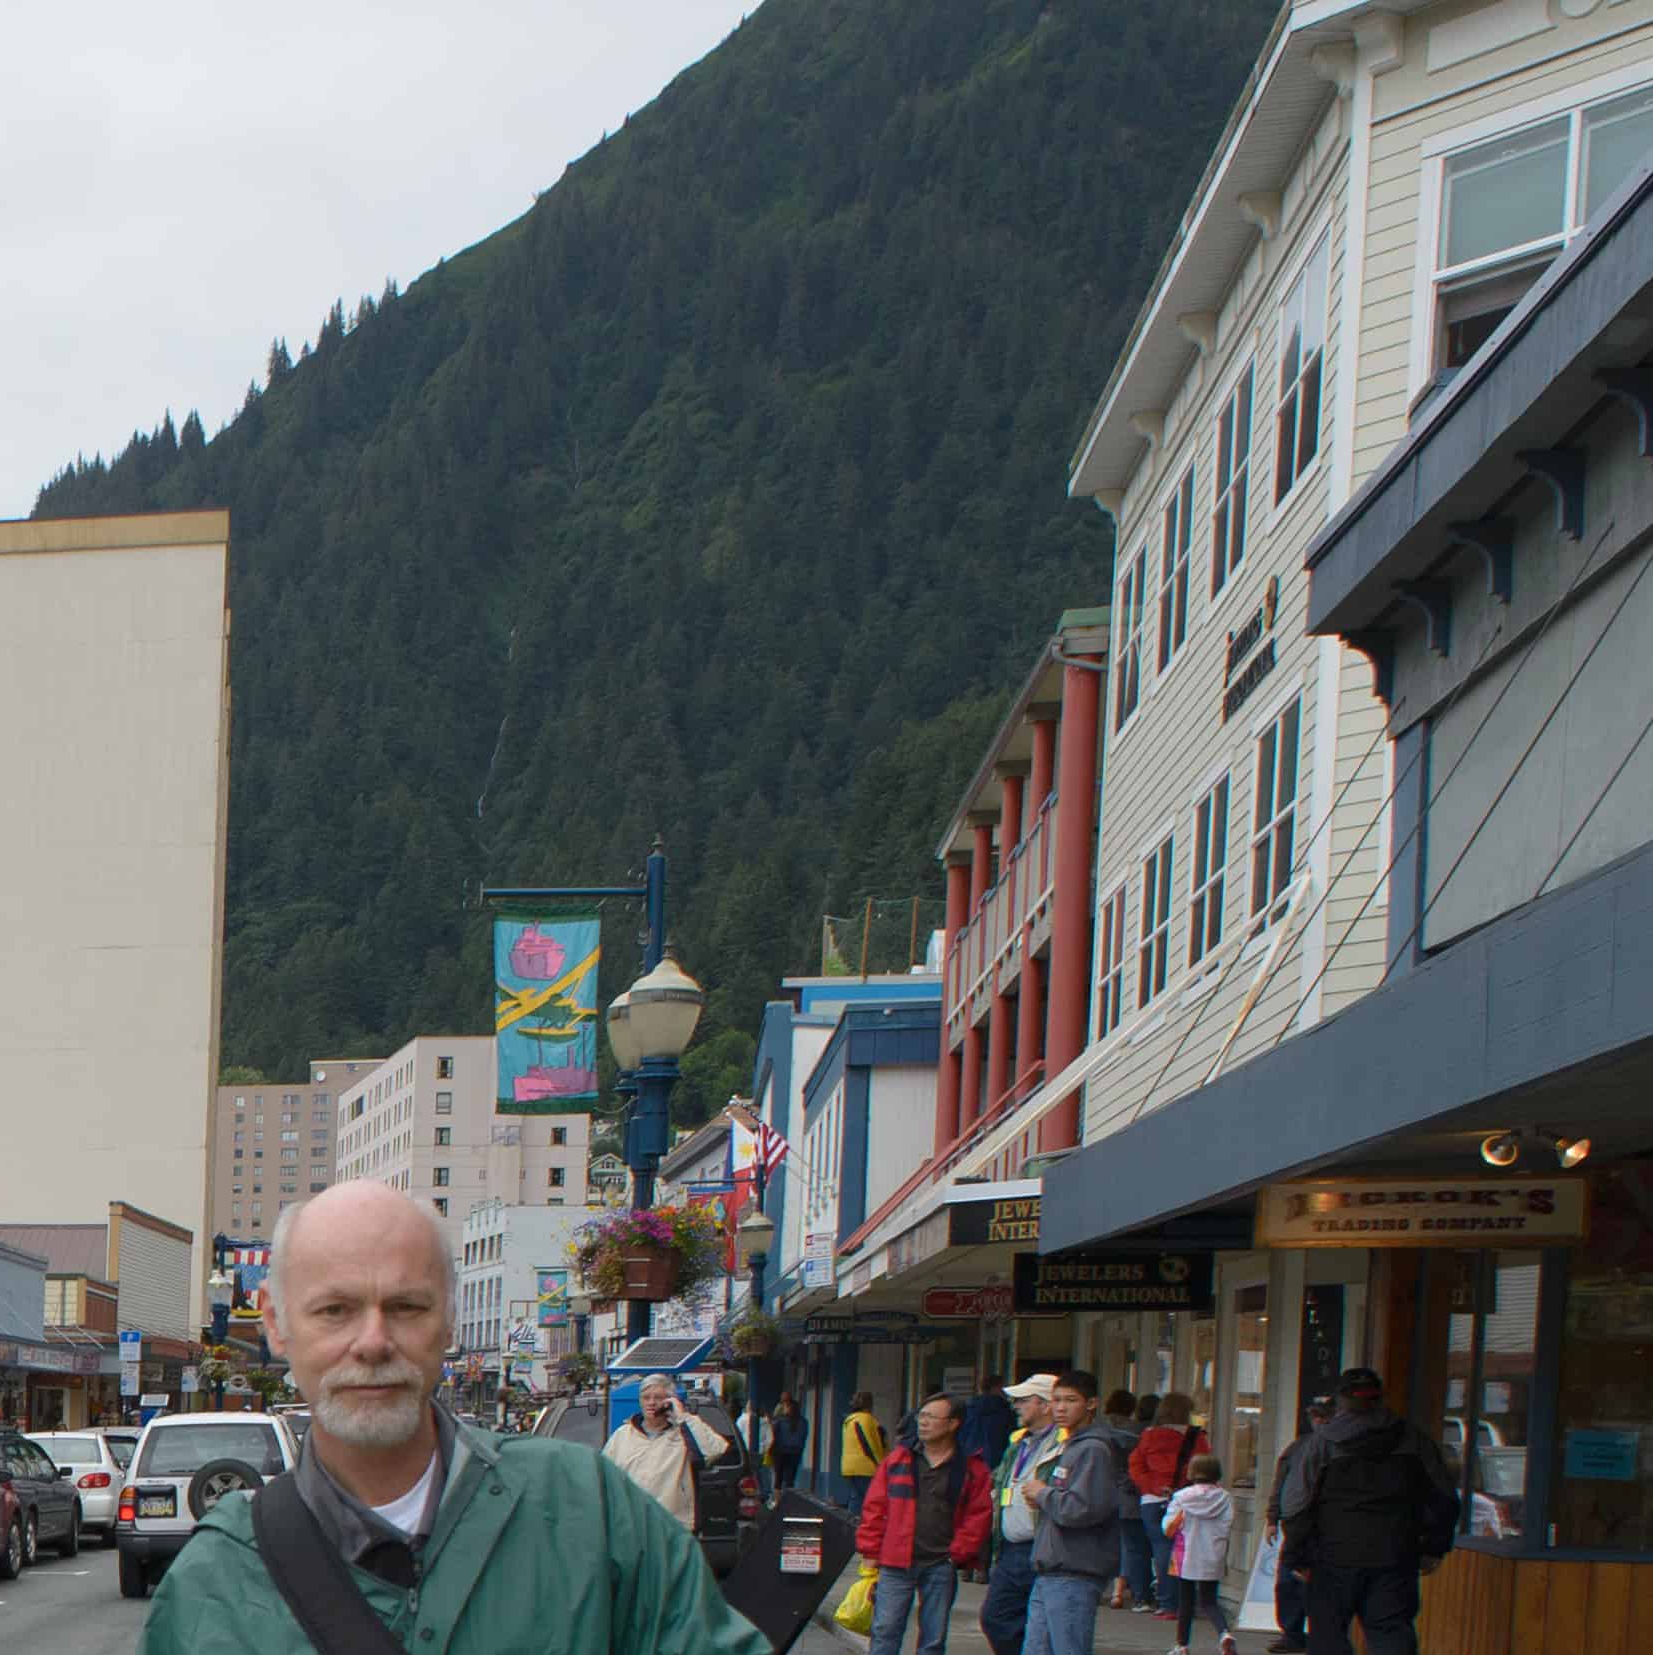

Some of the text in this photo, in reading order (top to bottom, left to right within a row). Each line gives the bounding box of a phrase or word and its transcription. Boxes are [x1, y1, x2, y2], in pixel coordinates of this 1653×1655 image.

[1312, 1215, 1526, 1233] TRADING COMPANY
[1034, 1263, 1144, 1286] JEWELERS
[1036, 1287, 1191, 1304] INTERNATIONAL
